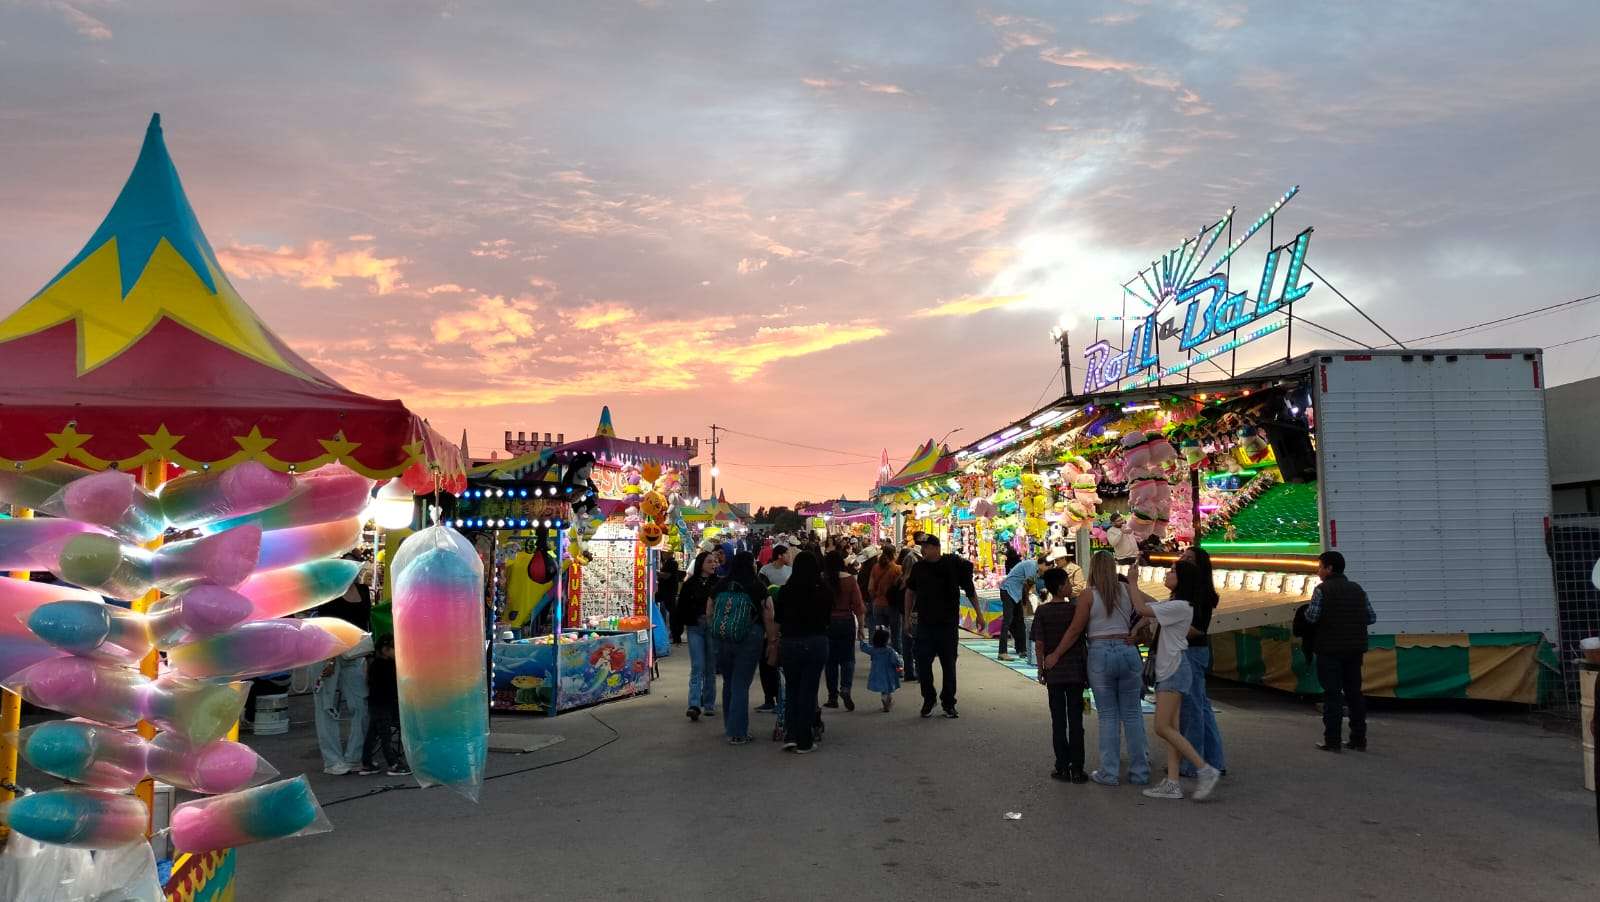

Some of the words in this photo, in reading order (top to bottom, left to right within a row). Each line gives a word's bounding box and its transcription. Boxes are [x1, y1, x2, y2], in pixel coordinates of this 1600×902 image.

[1083, 313, 1158, 395] Roll
[1174, 226, 1314, 352] Ball
[571, 563, 580, 622] TUAJ
[636, 546, 645, 615] EMPORA
